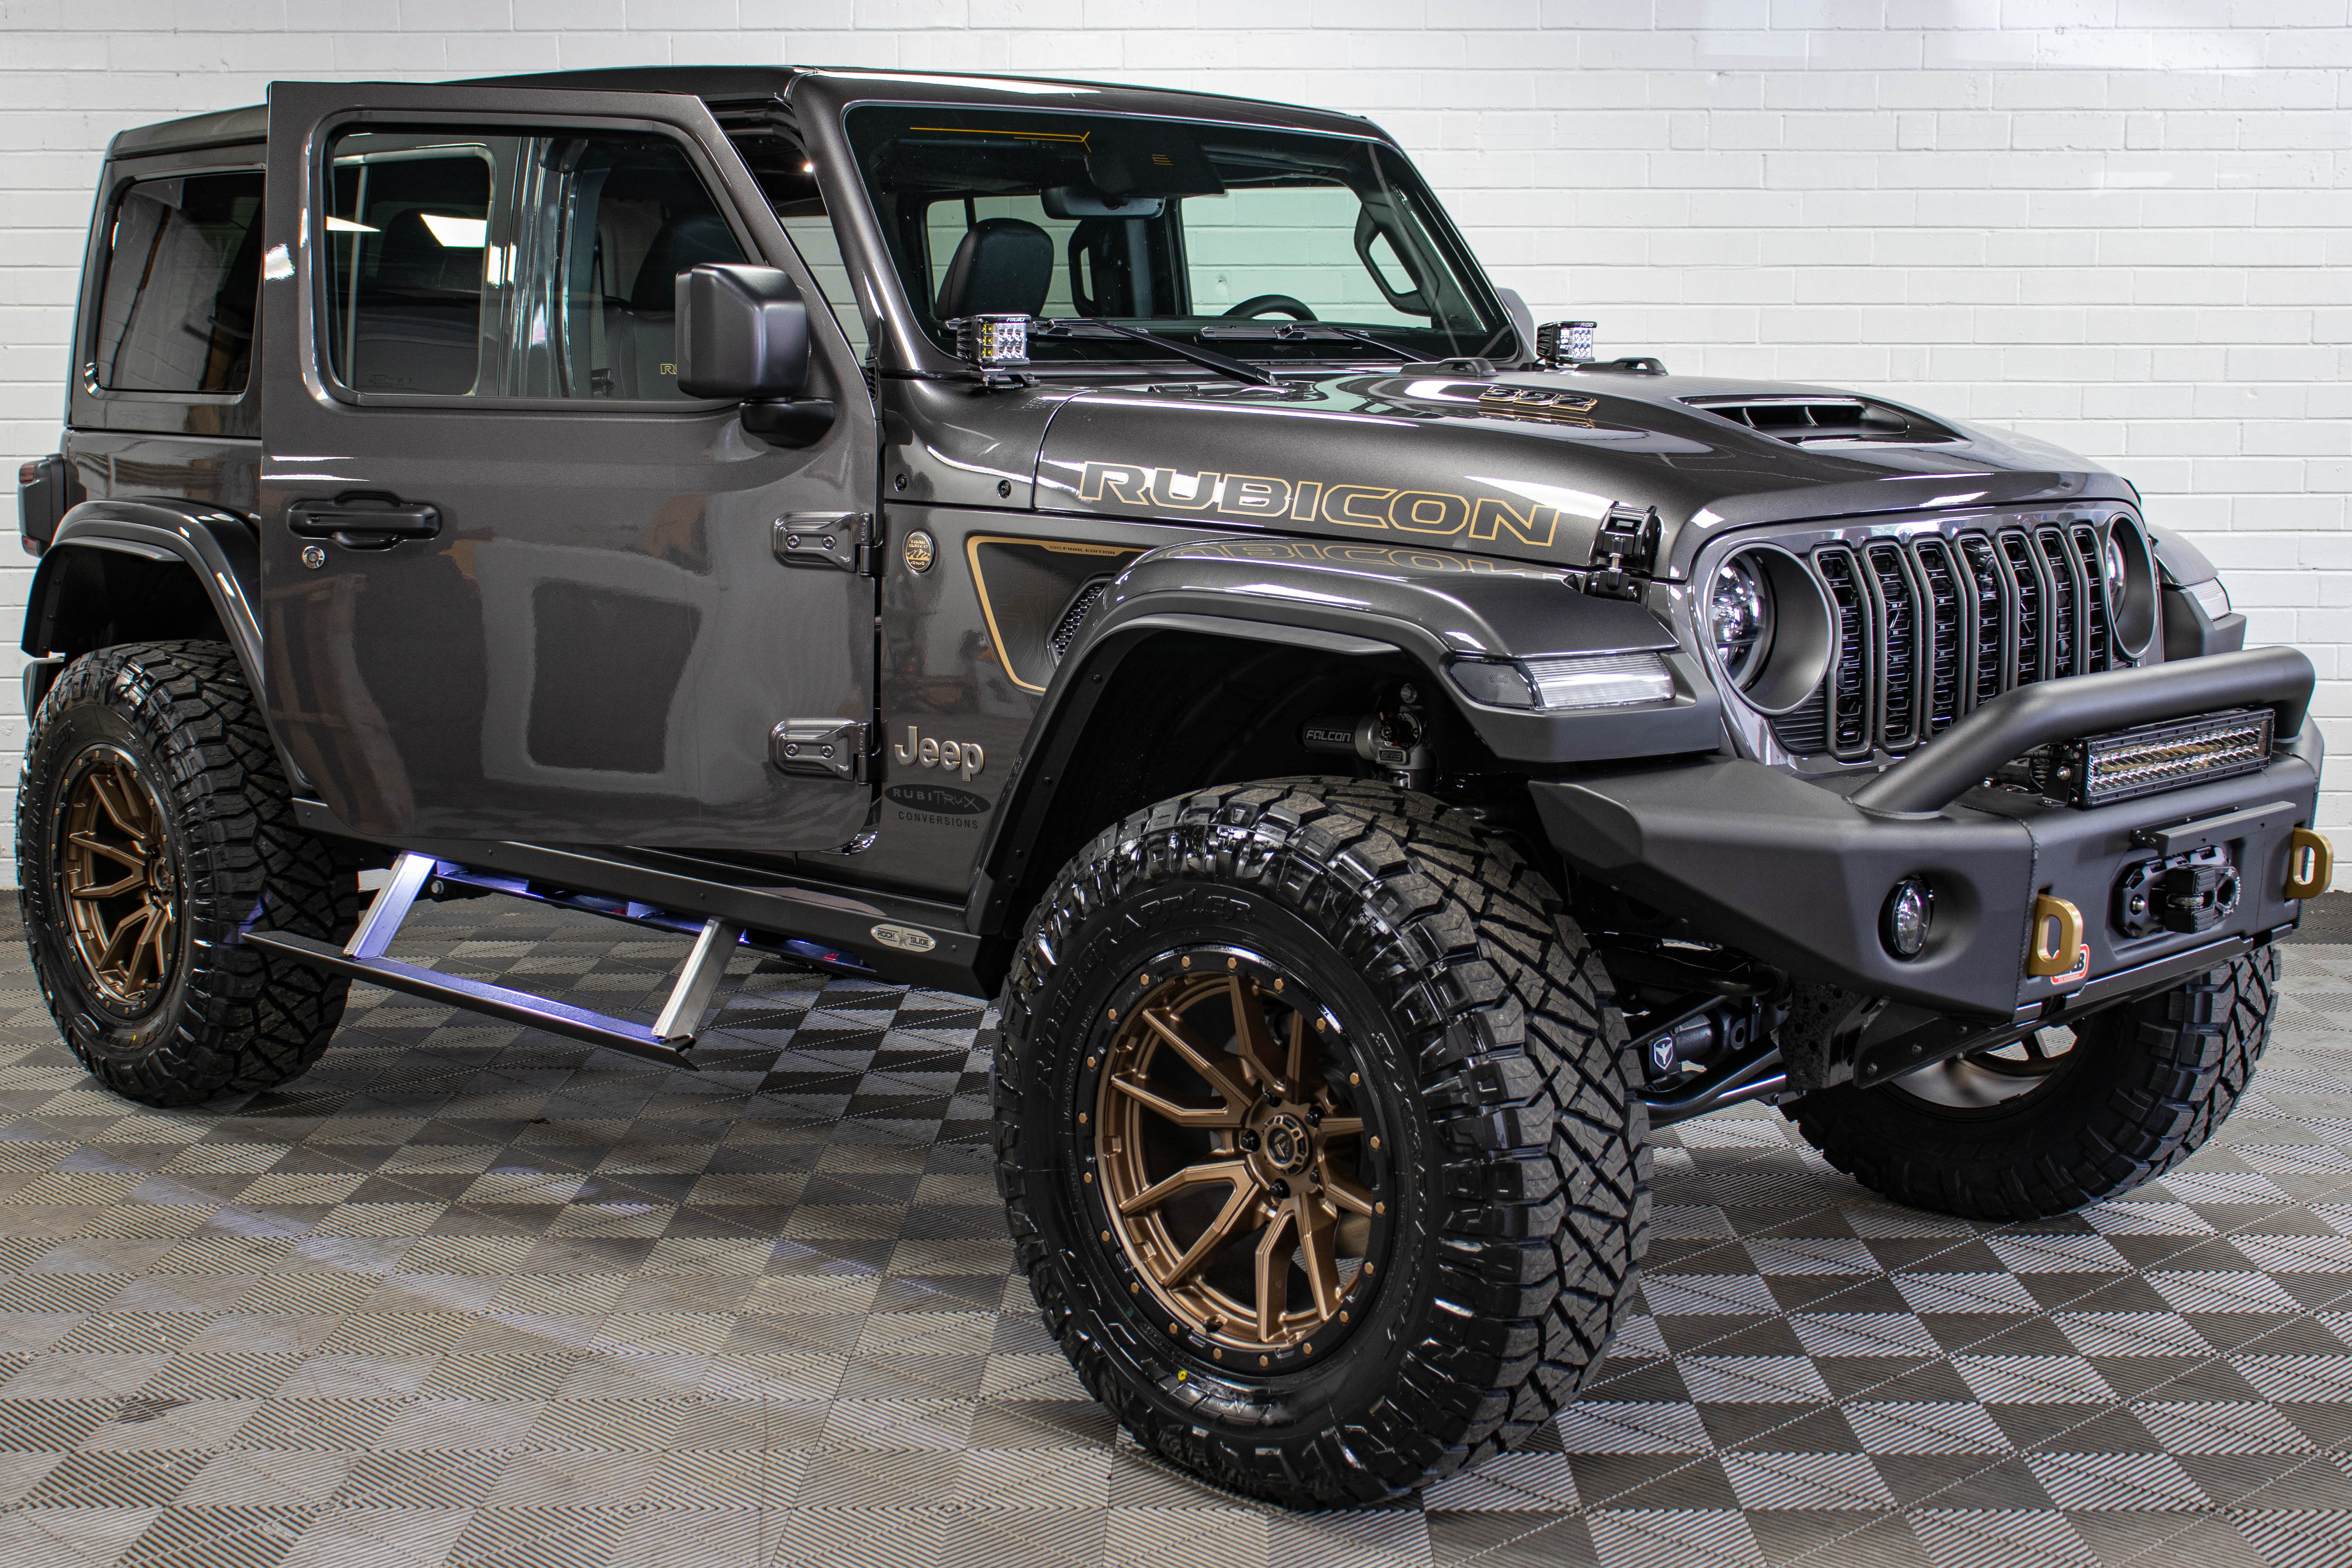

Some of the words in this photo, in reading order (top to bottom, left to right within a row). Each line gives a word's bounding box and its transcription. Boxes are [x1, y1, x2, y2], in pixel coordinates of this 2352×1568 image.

[1478, 386, 1598, 411] 392
[1078, 461, 1560, 547] RUBICON
[1306, 730, 1351, 742] FALCON
[894, 726, 984, 781] Jeep
[898, 811, 978, 829] CONVERSIONS
[877, 929, 896, 940] ROCK
[910, 936, 929, 947] SLIDE
[1079, 888, 1255, 973] GRAPPLER
